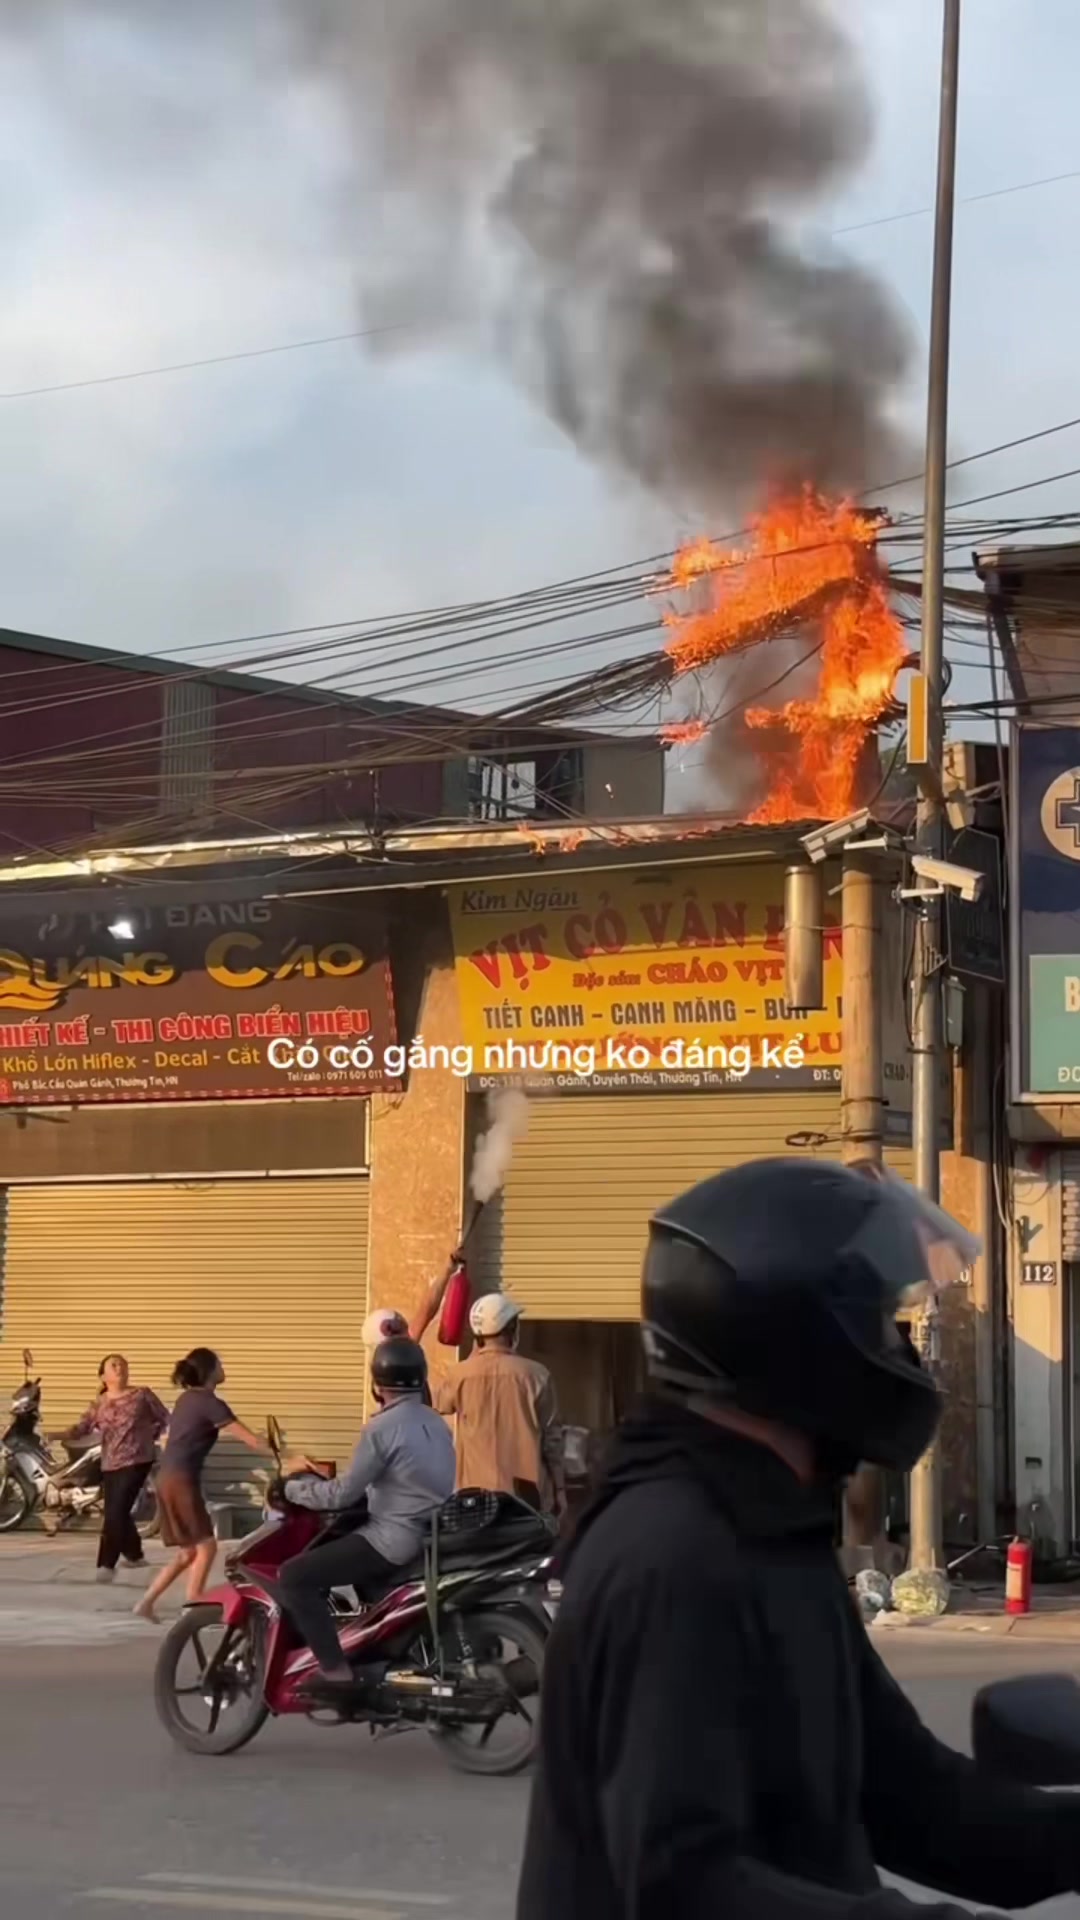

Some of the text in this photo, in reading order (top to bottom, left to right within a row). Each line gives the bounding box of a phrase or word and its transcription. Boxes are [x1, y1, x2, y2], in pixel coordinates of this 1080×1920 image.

[461, 889, 507, 912] Kim
[469, 923, 551, 991] VỊT
[565, 890, 628, 960] CỎ
[648, 956, 728, 985] CHÁO
[733, 958, 785, 987] VỊT
[56, 1014, 91, 1045] KẾ
[111, 1018, 154, 1044] THI
[159, 1012, 232, 1042] CÔNG
[237, 1004, 301, 1038] BIỂN
[306, 1005, 371, 1039] HIỆU
[484, 998, 523, 1029] TIẾT
[531, 1004, 585, 1028] CANH
[611, 1001, 666, 1026] CANH
[674, 997, 737, 1024] MĂNG
[3, 1051, 38, 1073] Khổ
[44, 1052, 77, 1071] Lớn
[83, 1052, 137, 1071] Hiflex
[155, 1049, 208, 1068] Decal
[227, 1042, 261, 1065] Cắt
[1024, 1264, 1054, 1282] 112
